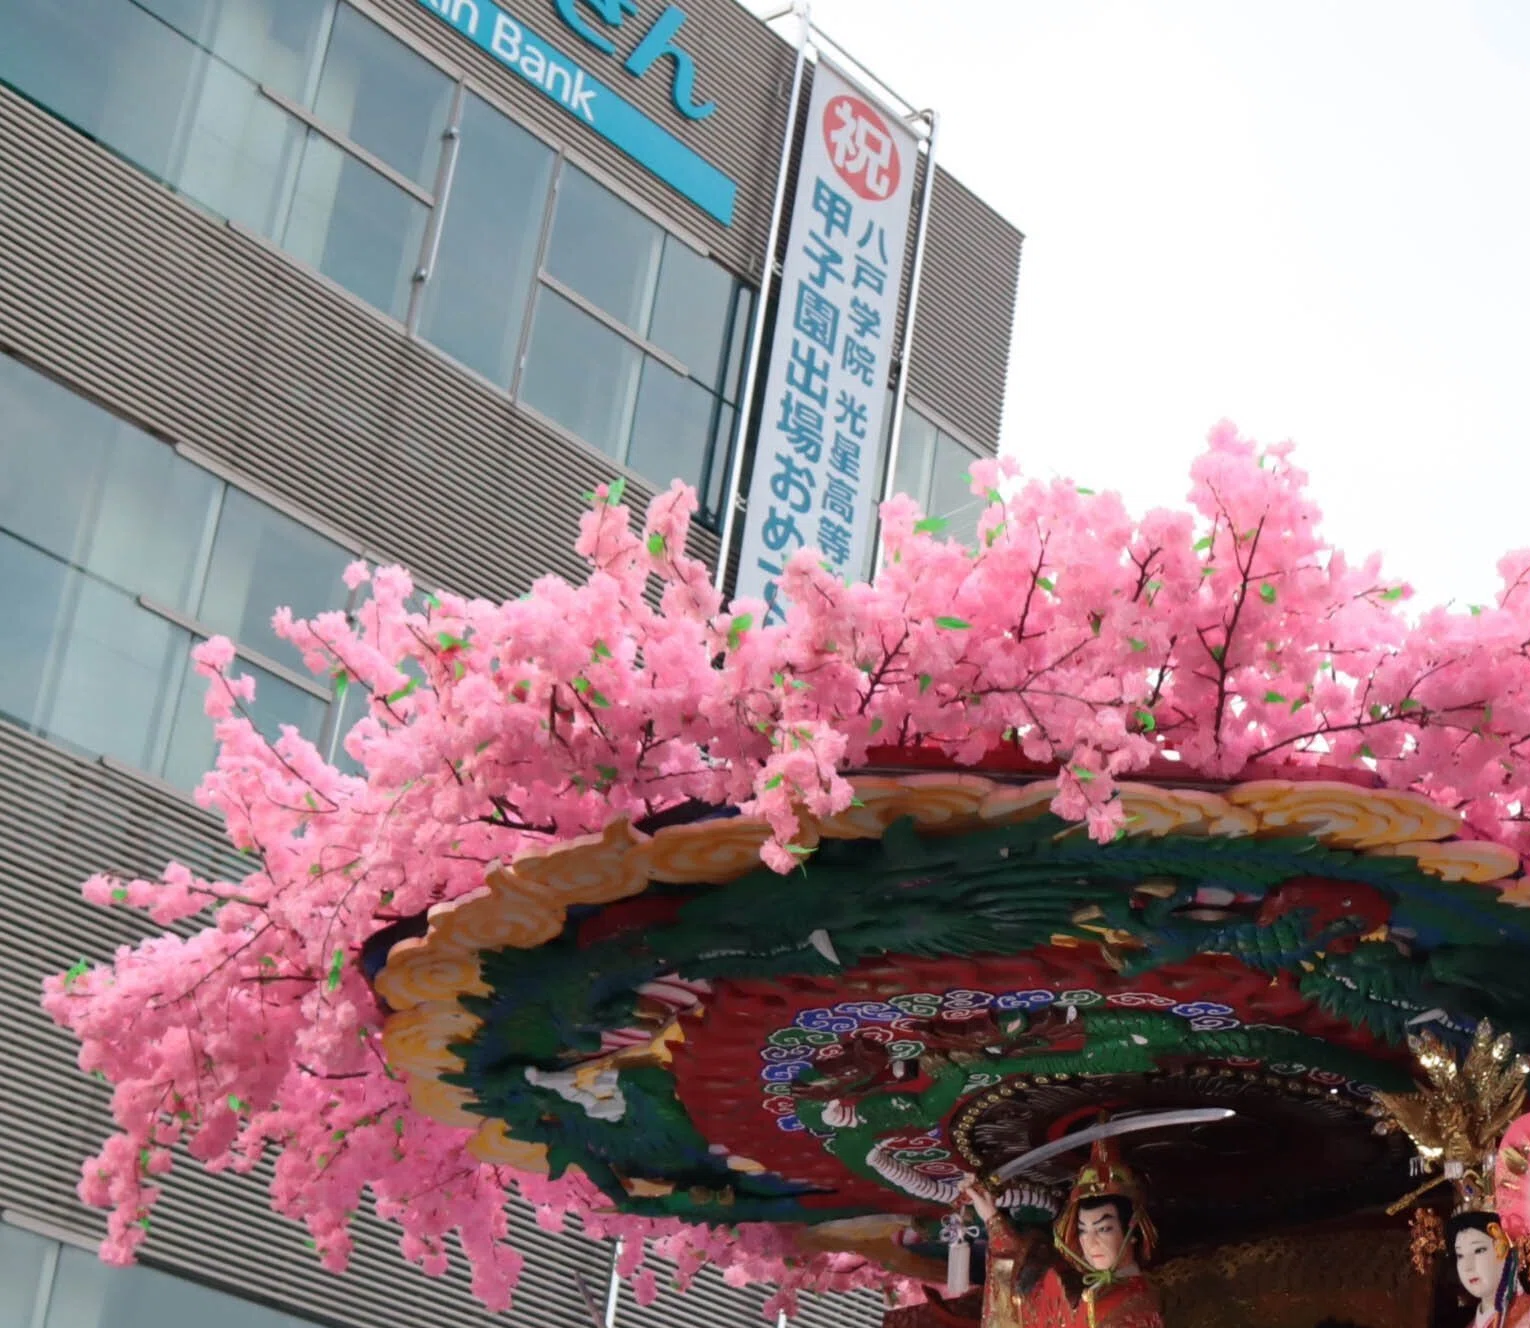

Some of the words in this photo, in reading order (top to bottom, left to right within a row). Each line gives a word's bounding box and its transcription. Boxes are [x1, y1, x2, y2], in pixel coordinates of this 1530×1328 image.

[490, 12, 598, 122] Bank
[830, 100, 892, 198] 祝
[841, 219, 889, 388] 八戸学院
